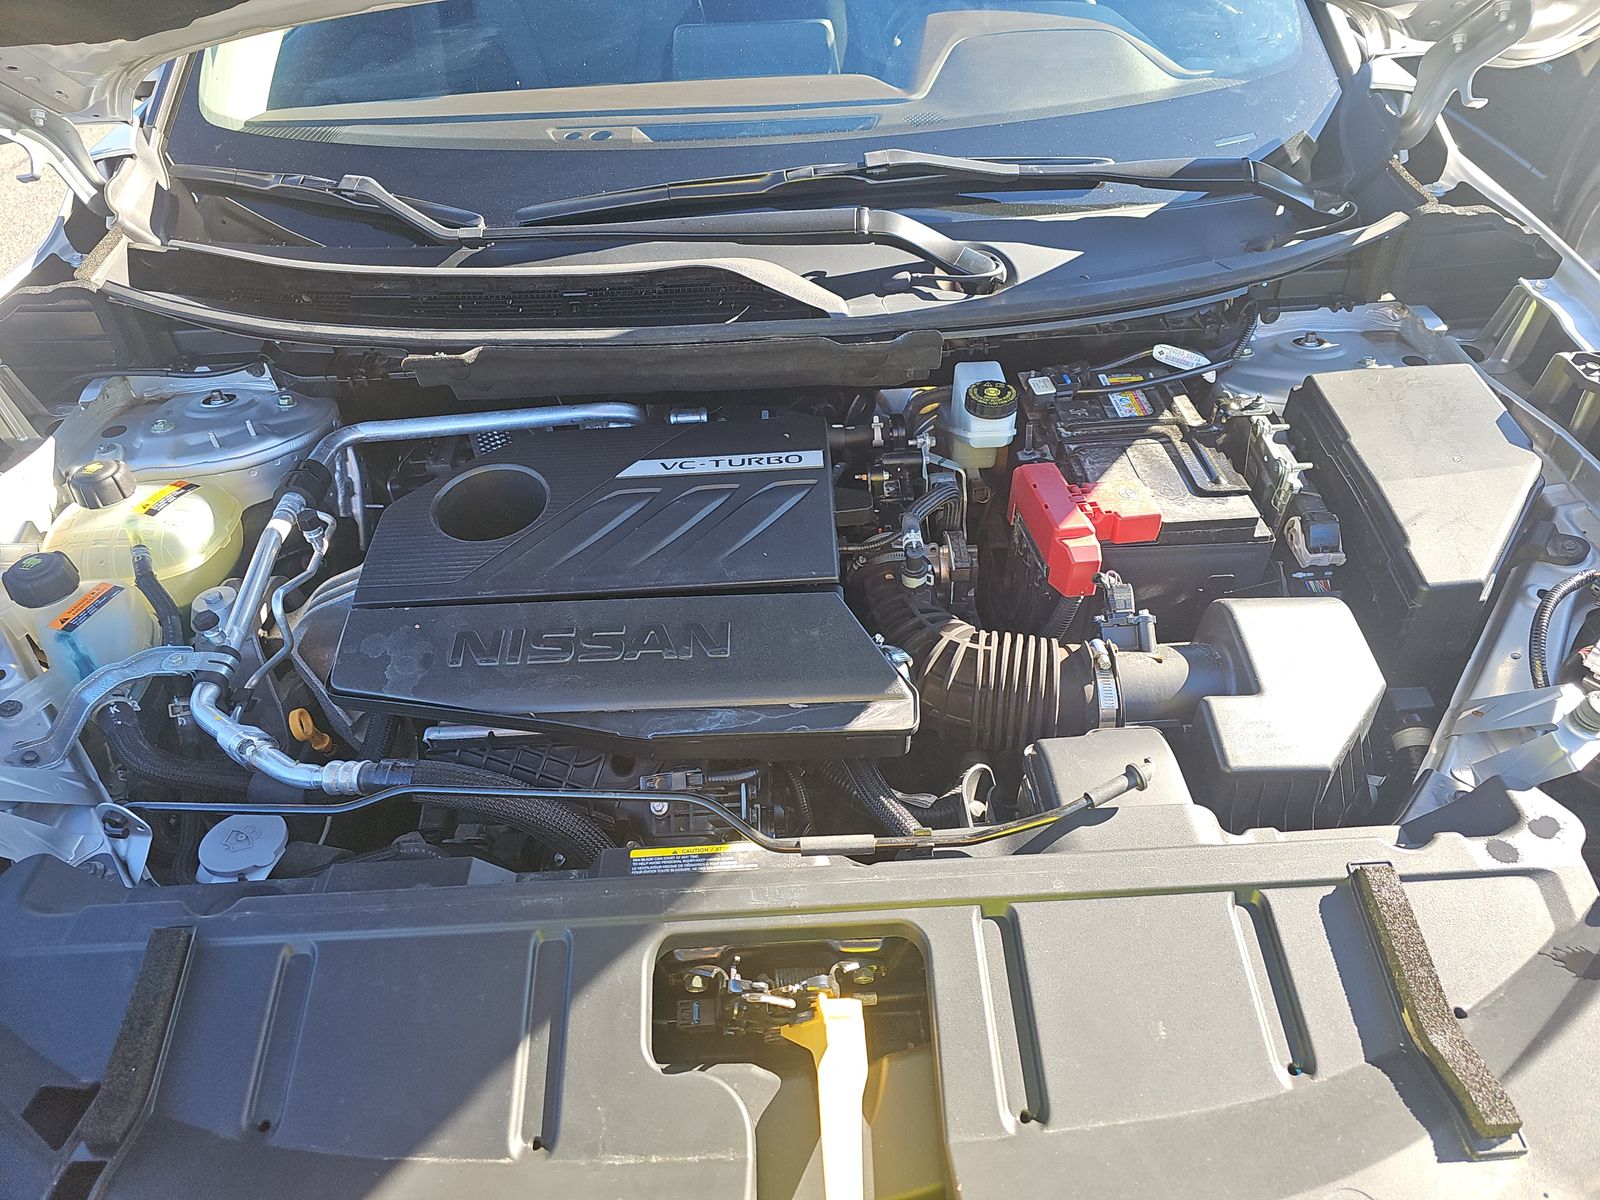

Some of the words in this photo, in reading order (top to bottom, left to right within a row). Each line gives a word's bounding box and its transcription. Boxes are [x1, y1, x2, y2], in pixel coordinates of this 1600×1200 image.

[659, 454, 803, 471] VC-TURBO
[448, 621, 731, 668] NISSAN
[681, 846, 709, 854] CAUTION
